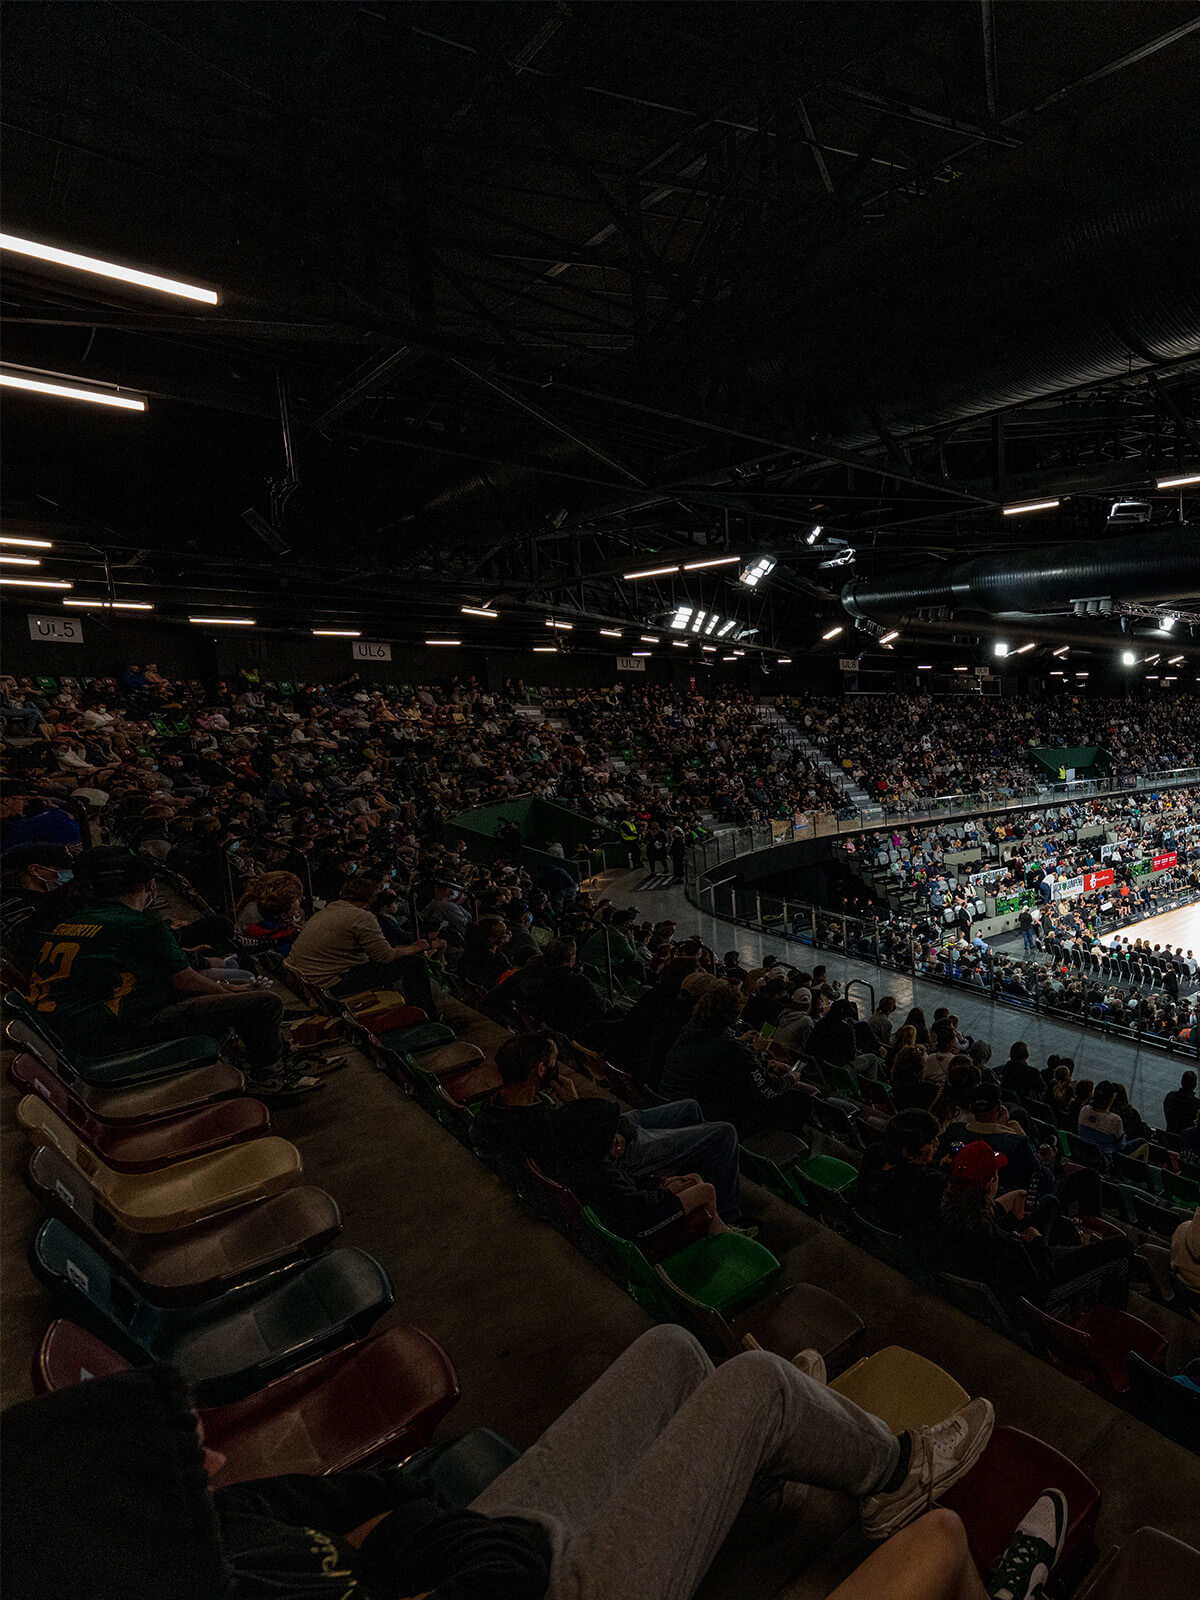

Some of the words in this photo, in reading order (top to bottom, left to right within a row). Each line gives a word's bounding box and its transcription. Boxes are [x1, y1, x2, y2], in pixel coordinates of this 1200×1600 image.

[37, 620, 75, 638] UL5
[358, 645, 386, 658] UL6
[621, 659, 641, 668] UL7
